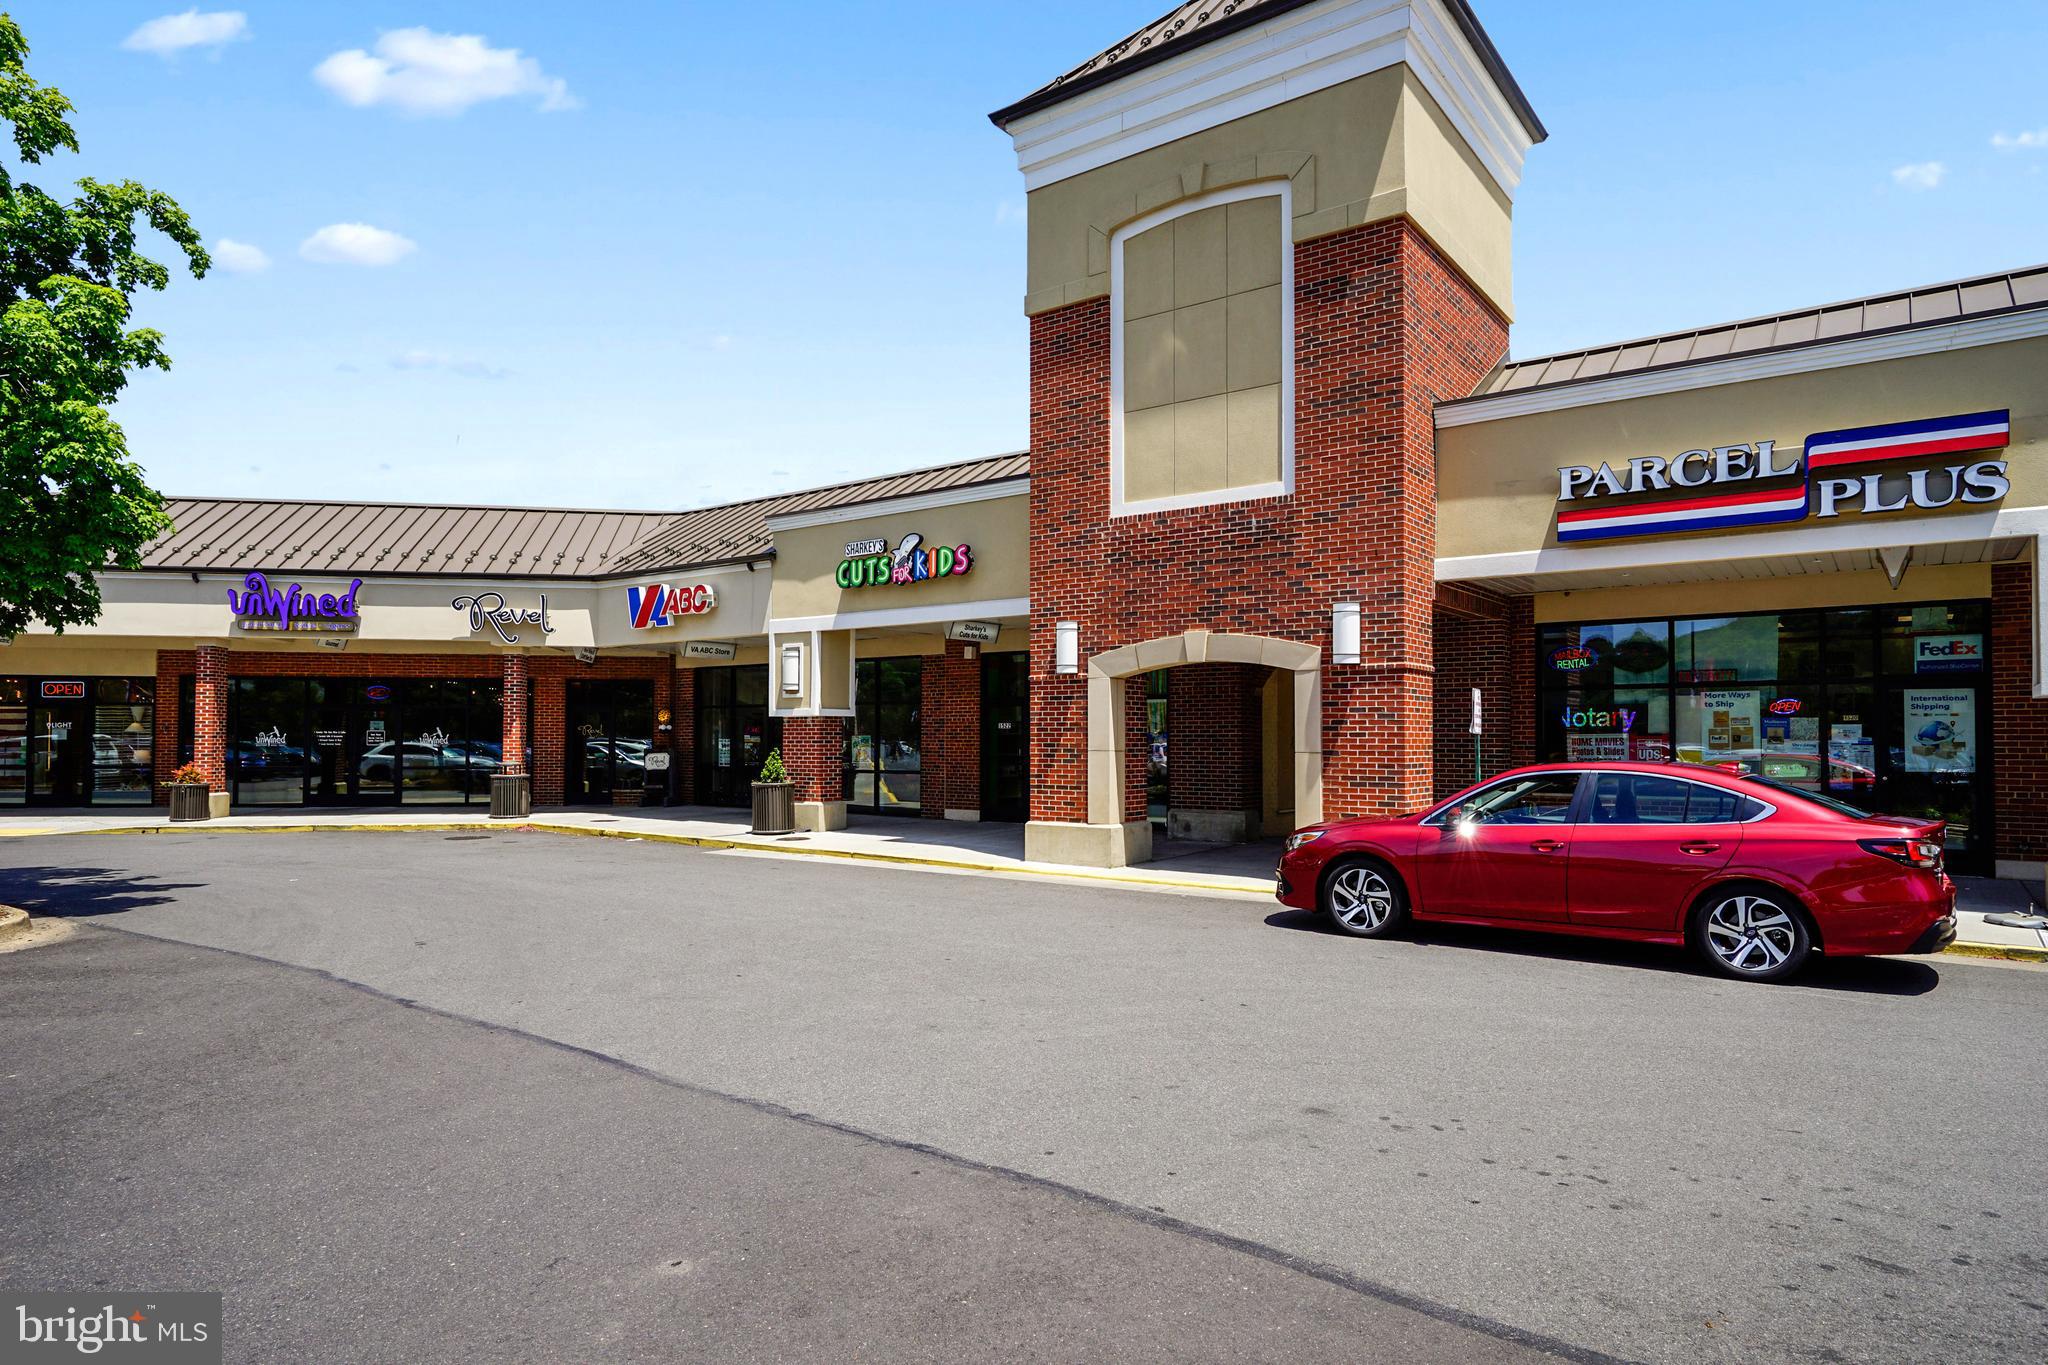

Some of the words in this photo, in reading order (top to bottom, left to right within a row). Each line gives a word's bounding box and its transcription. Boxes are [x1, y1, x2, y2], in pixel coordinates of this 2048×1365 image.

[1557, 440, 1801, 501] PARCEL
[1816, 460, 2010, 518] PLUS
[846, 540, 884, 556] SHARKEY'S
[836, 556, 891, 588] CUTS
[891, 565, 913, 584] FOR
[913, 544, 970, 581] KIDS
[661, 584, 710, 615] ABC
[452, 592, 556, 643] Revel
[964, 624, 986, 633] Sharkey's
[1920, 641, 1977, 656] FedEx
[1556, 658, 1590, 669] RENTAL
[44, 684, 82, 695] OPEN
[1728, 691, 1751, 699] Ways
[1715, 700, 1734, 708] Ship
[1769, 701, 1801, 712] OPEN
[1910, 703, 1950, 711] Shipping
[1571, 738, 1593, 746] HOME
[1595, 737, 1625, 746] MOVIES
[1572, 747, 1594, 756] Photos
[1596, 747, 1602, 756] &
[1604, 747, 1625, 756] Slides
